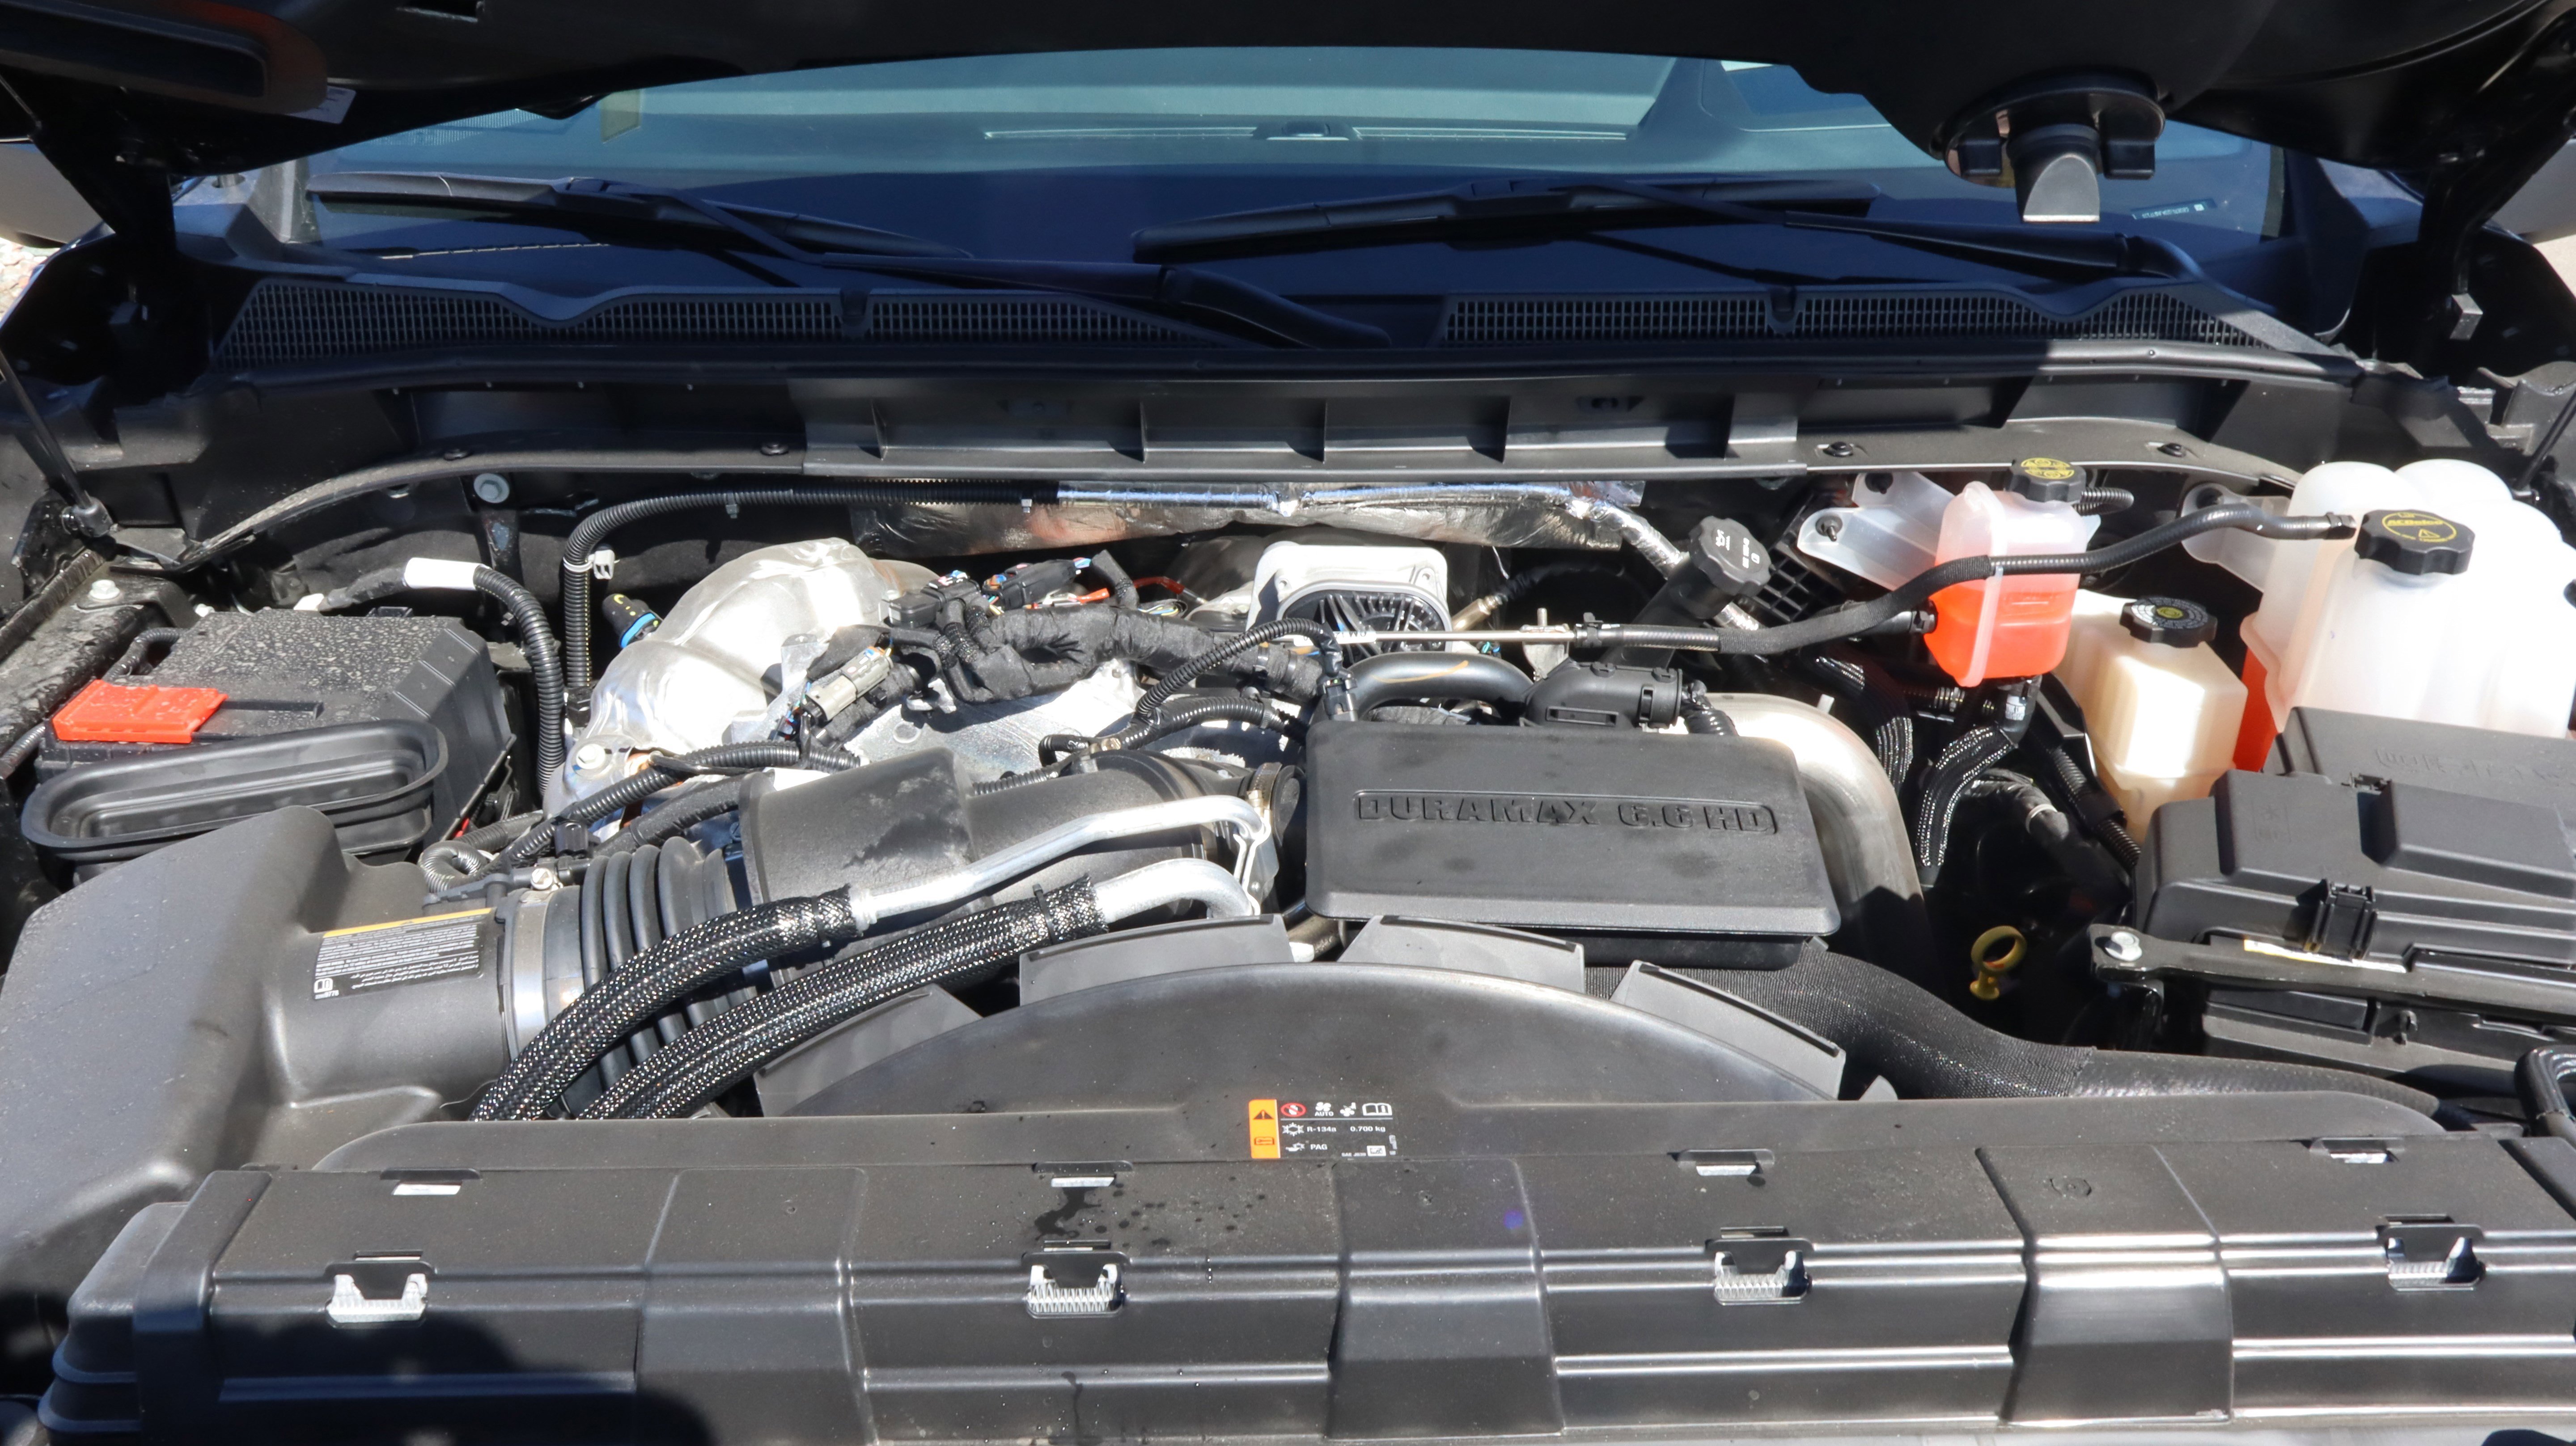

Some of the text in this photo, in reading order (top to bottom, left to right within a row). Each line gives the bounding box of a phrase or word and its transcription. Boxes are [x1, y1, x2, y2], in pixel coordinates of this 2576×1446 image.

[1358, 797, 1769, 832] DURAMAX 6.6 HD
